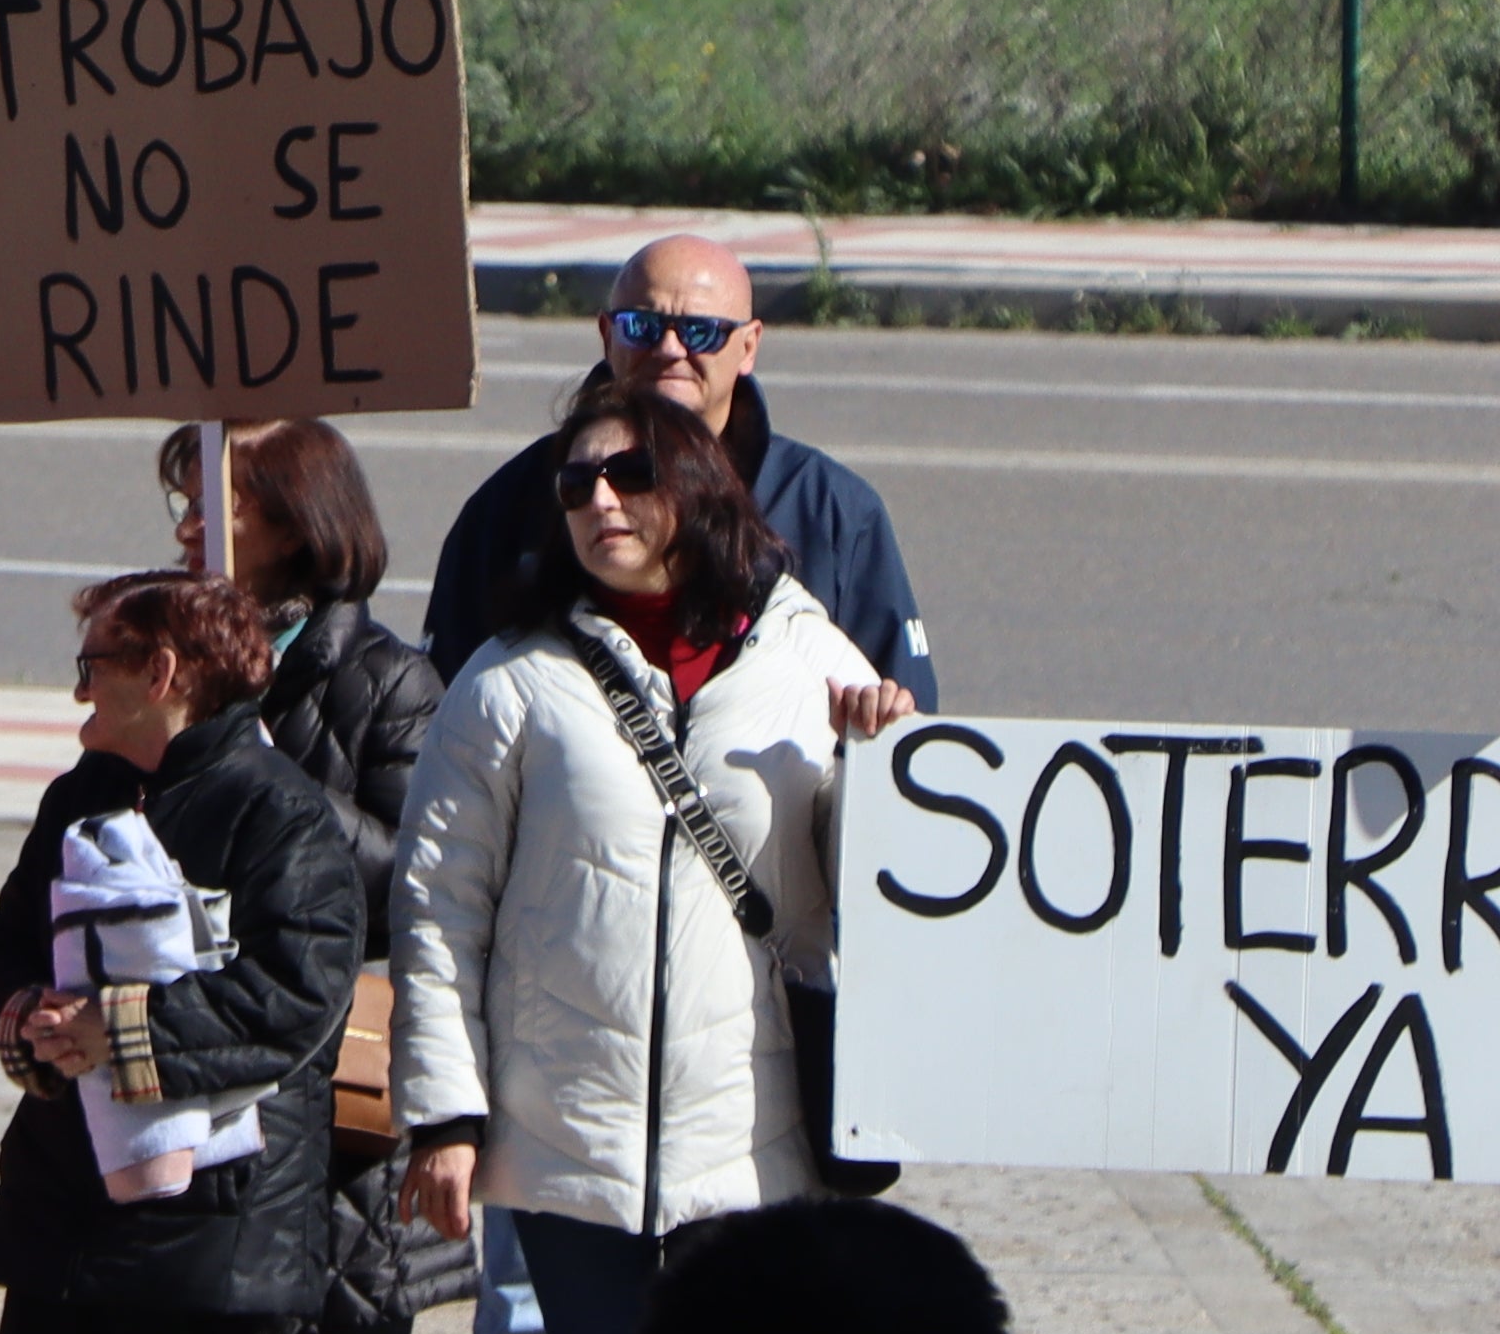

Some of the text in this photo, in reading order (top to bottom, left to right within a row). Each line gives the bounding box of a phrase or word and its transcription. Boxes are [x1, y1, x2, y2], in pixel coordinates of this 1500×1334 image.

[64, 122, 382, 240] NO SE
[39, 261, 382, 400] RINDE
[652, 753, 686, 788] TO
[691, 818, 738, 873] YOU
[1223, 980, 1452, 1180] YA
